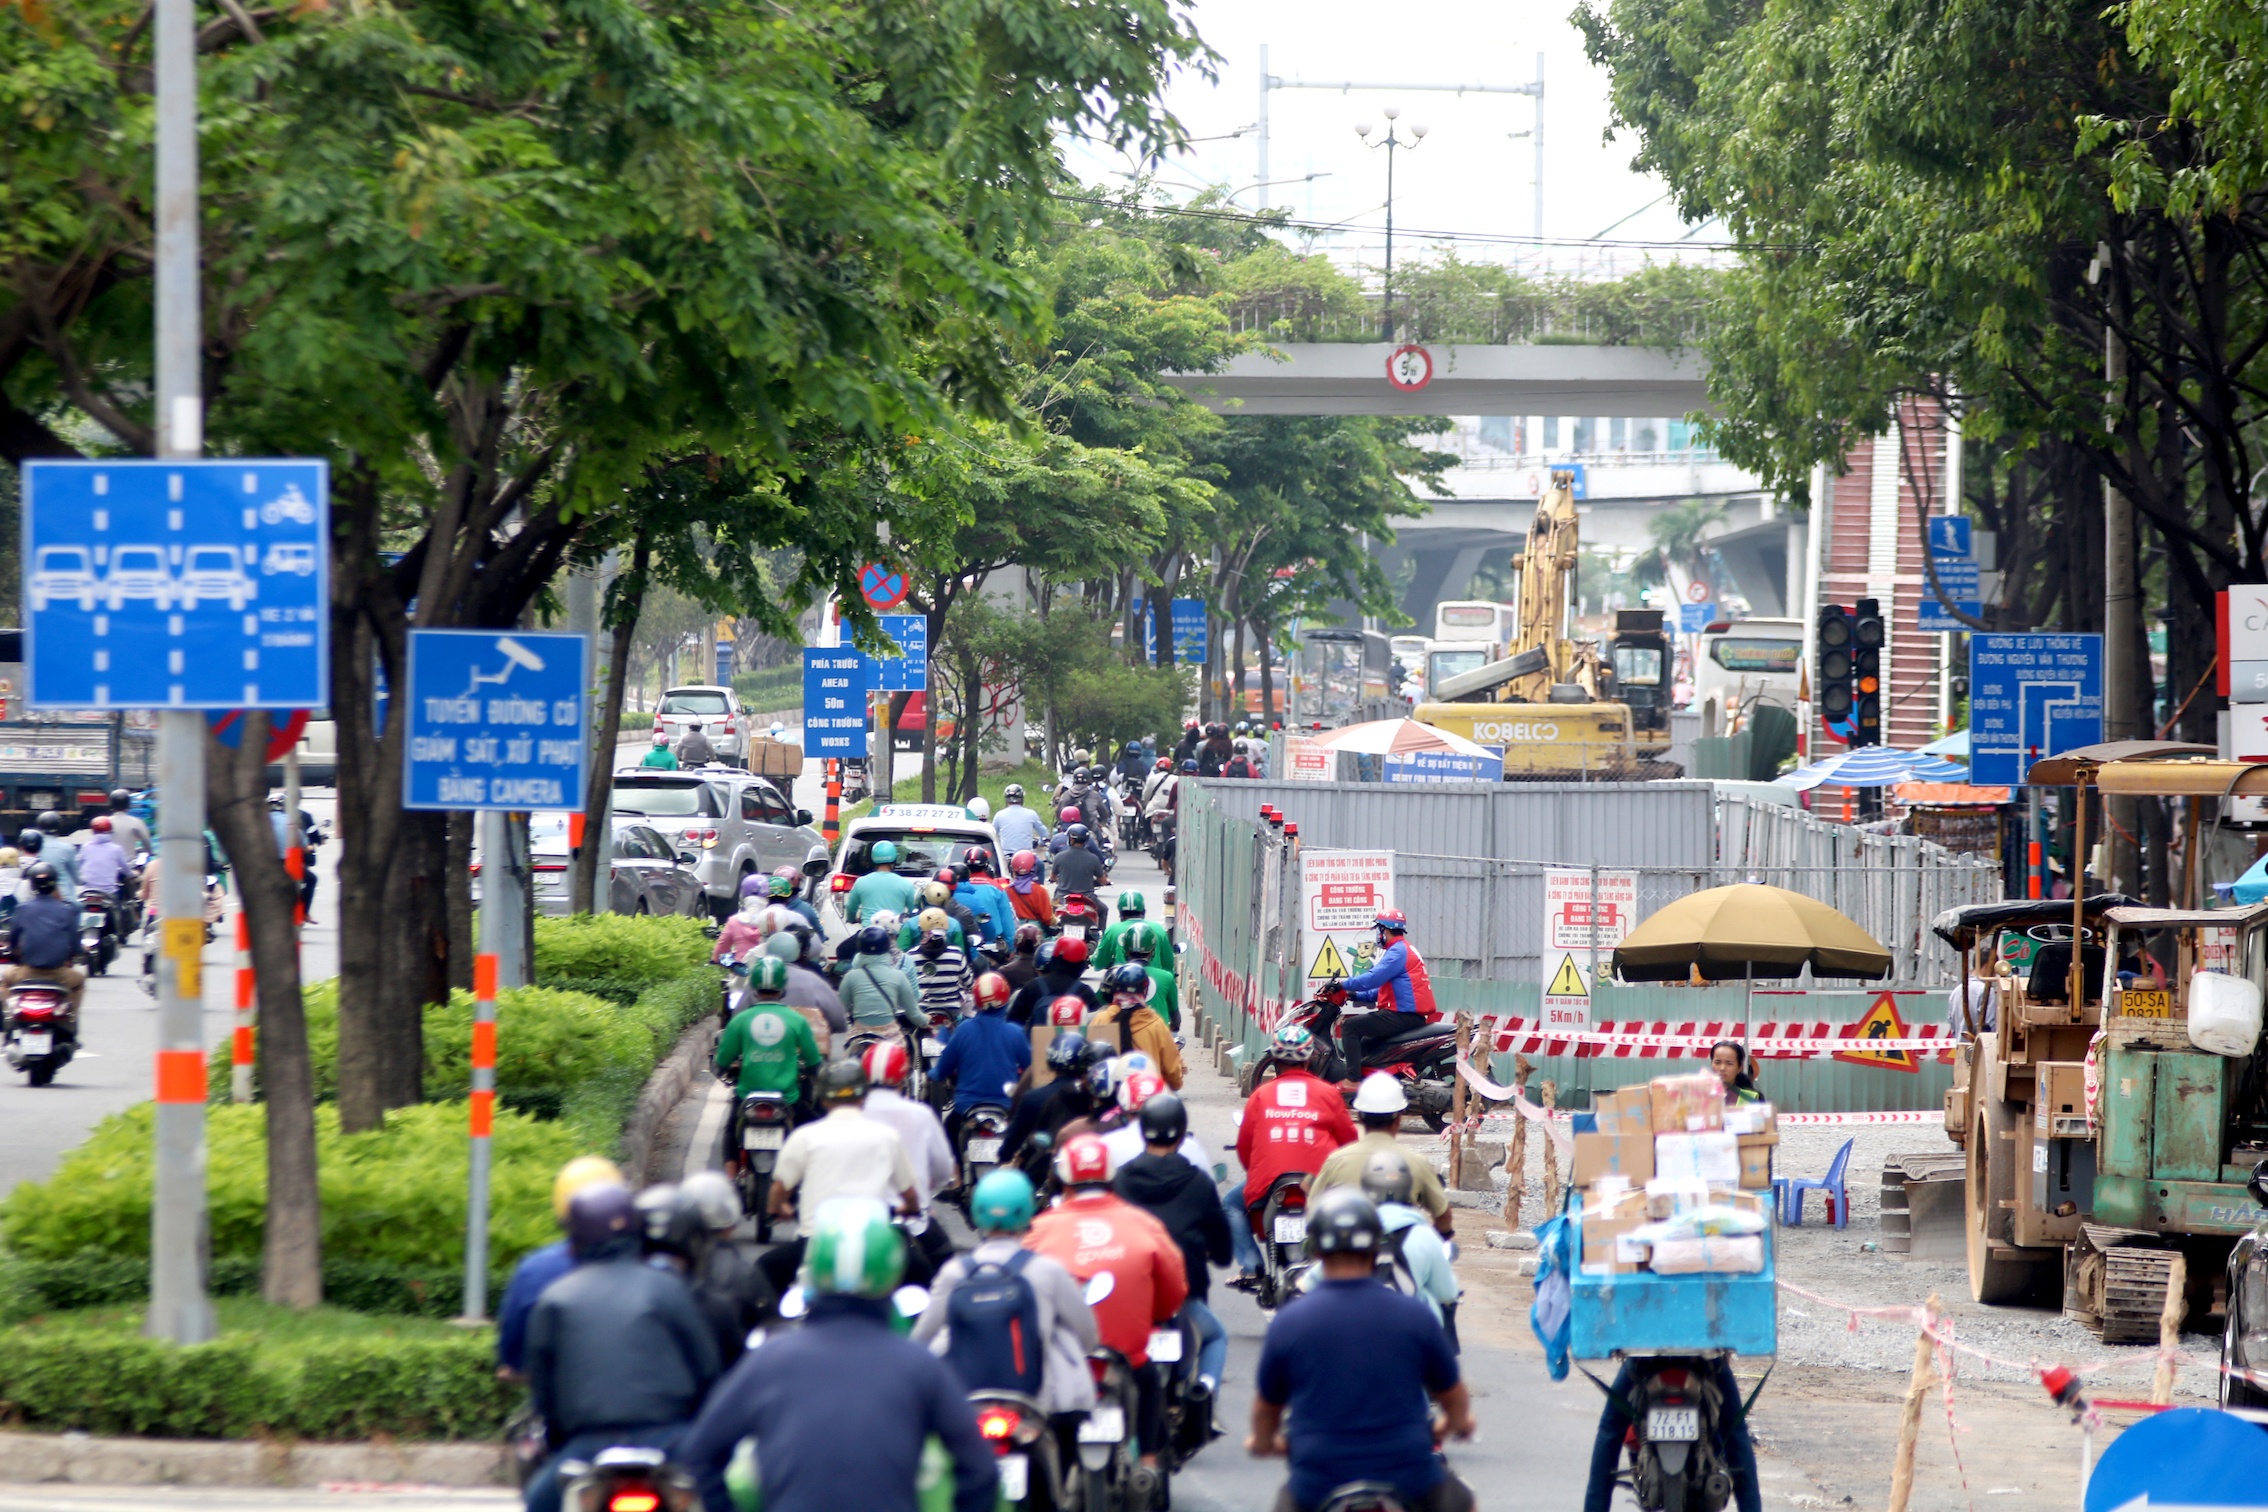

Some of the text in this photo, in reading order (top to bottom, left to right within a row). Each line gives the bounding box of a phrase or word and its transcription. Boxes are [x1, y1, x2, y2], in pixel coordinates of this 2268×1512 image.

[811, 657, 858, 669] PHÍA TRƯỚC
[822, 678, 849, 688] AHEAD
[2255, 672, 2268, 689] 5
[825, 697, 844, 709] 50m
[425, 693, 578, 726] TUYẾN ĐƯỜNG CÓ
[807, 716, 863, 728] CÔNG TRƯỜNG
[1474, 722, 1559, 740] KOBELCO
[412, 730, 456, 763] GIÁM
[538, 739, 582, 771] PHẠT
[1468, 761, 1483, 770] NY
[438, 767, 564, 804] BẰNG CAMERA
[931, 809, 944, 818] 27
[947, 810, 960, 819] 27
[1330, 886, 1344, 894] CÔNG
[1353, 896, 1367, 904] CÔNG
[1572, 904, 1587, 912] CÔNG
[2124, 992, 2166, 1008] 50-SA
[1550, 1010, 1584, 1024] 5Km/h
[1265, 1109, 1318, 1121] NowFood
[1656, 1411, 1689, 1425] 72-F1
[1652, 1426, 1695, 1439] 318.15
